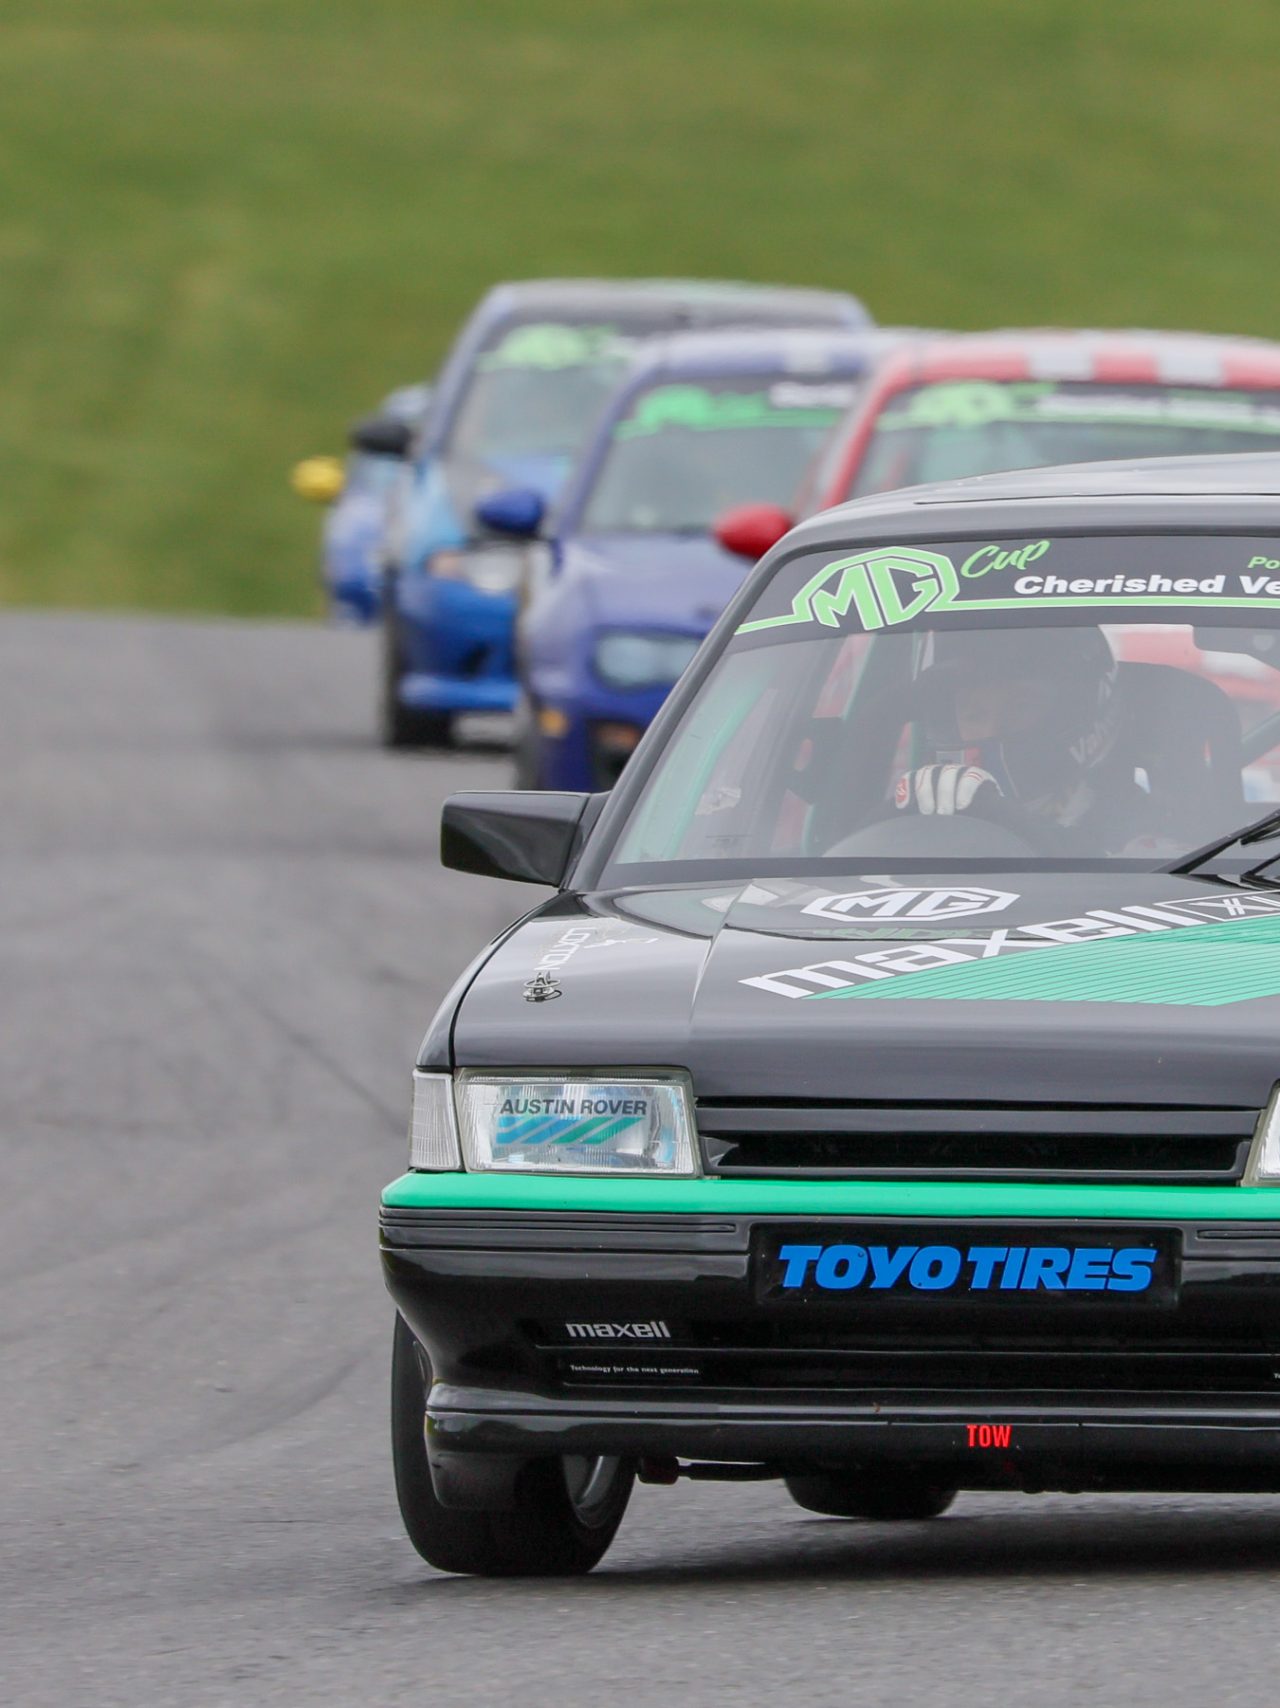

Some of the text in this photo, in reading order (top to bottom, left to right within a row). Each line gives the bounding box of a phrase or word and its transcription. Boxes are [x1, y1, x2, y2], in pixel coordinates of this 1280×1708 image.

[809, 540, 1050, 630] MG Cup
[1014, 575, 1225, 594] Cherished
[835, 890, 990, 919] MG
[738, 904, 1208, 999] maxell
[501, 1100, 647, 1116] AUSTIN ROVER
[778, 1244, 1157, 1291] TOYO TIRES
[565, 1321, 671, 1338] maxell
[569, 1365, 611, 1374] Technology
[966, 1424, 1013, 1448] TOW
